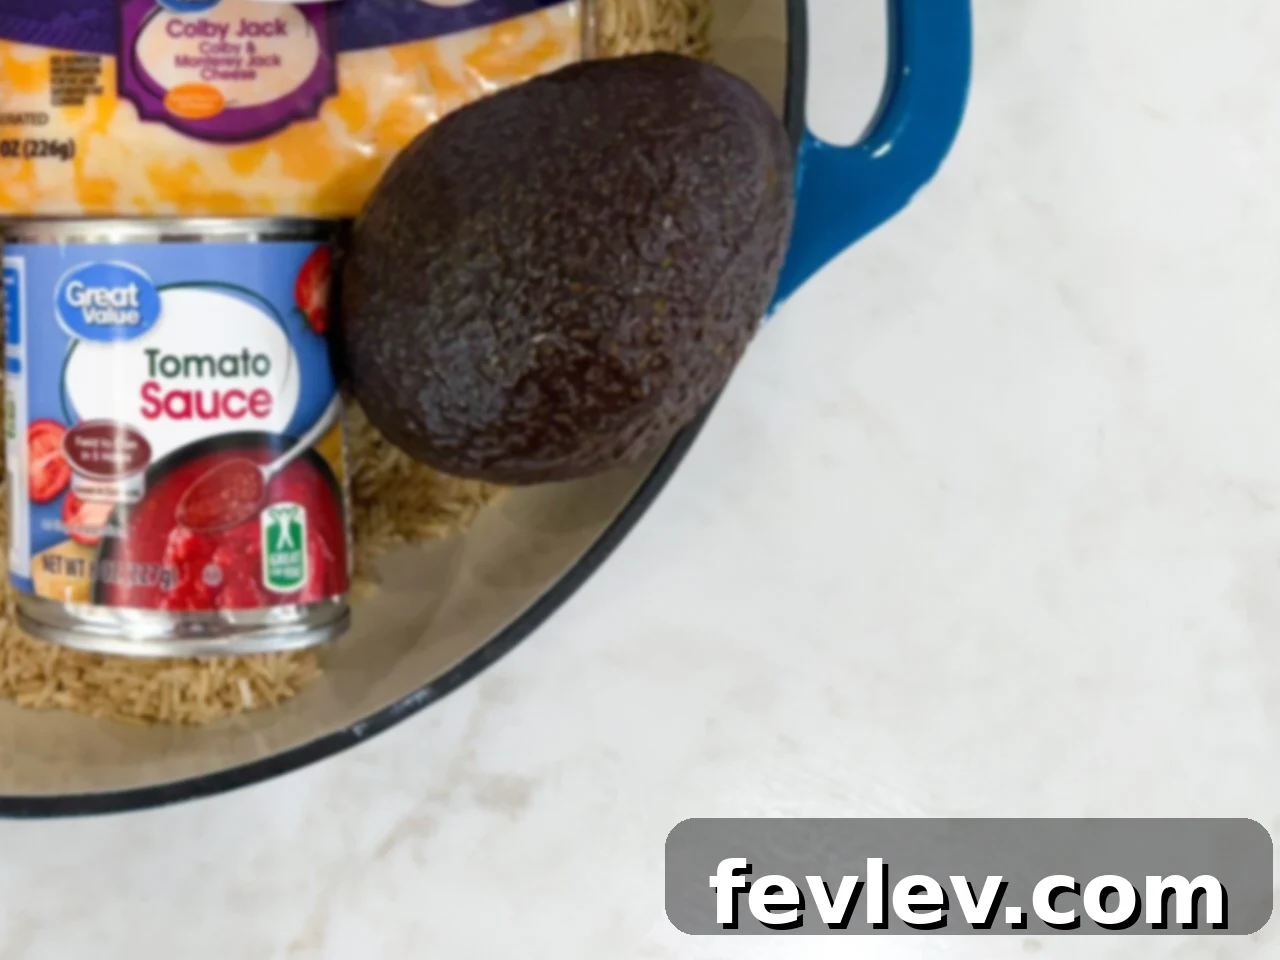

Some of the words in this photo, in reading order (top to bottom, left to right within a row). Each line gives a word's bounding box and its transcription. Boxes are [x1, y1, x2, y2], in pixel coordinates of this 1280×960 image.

[166, 18, 229, 41] Colby
[236, 17, 288, 37] Jack
[199, 41, 241, 55] Colby
[174, 55, 243, 70] Monterey
[248, 54, 281, 67] Jack
[200, 67, 257, 80] Cheese
[0, 140, 20, 158] OZ
[23, 138, 76, 161] (226g)
[66, 279, 139, 310] Great
[81, 306, 140, 327] Value
[144, 348, 271, 378] Tomato
[140, 382, 273, 420] Sauce
[65, 557, 84, 577] WT
